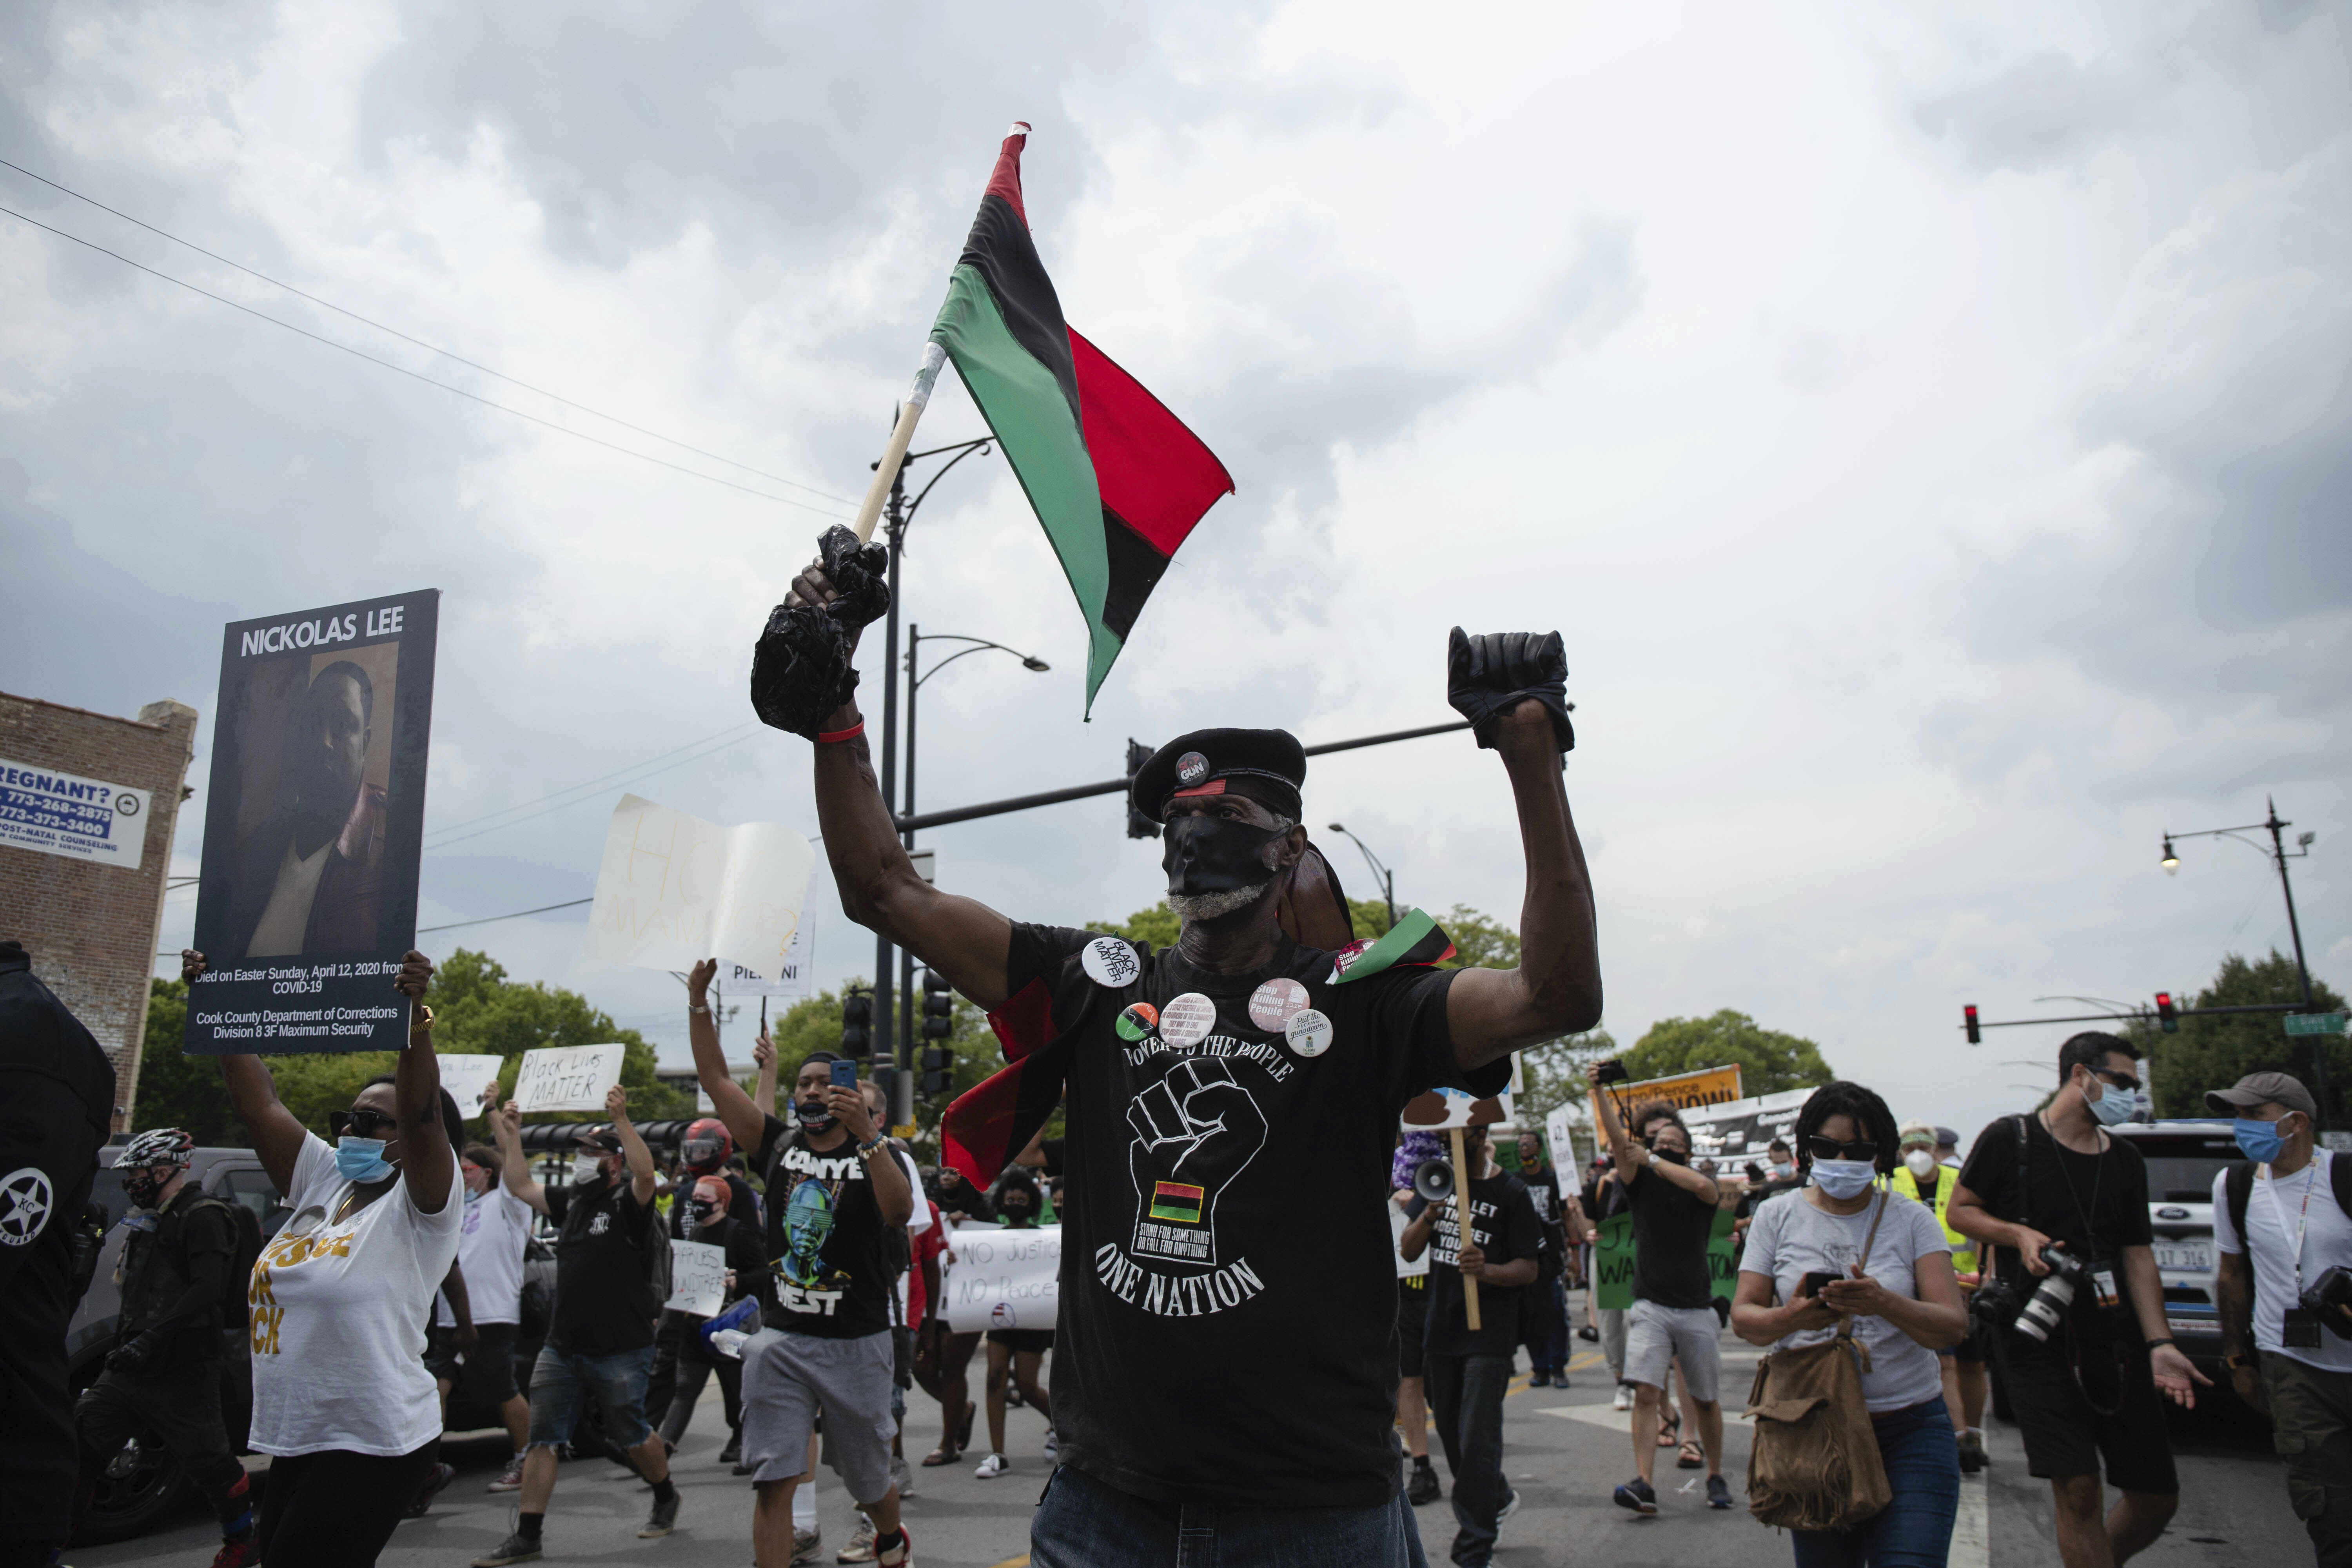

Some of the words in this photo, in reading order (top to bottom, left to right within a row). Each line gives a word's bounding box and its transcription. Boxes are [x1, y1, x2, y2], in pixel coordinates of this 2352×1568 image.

[241, 614, 357, 657] NICKOLAS
[366, 606, 404, 637] LEE
[1180, 762, 1204, 780] GUN
[1184, 771, 1206, 783] VIOLENCE
[7, 790, 111, 822] 773-268-2875
[9, 834, 56, 846] COMMUNITY
[60, 835, 117, 851] COUNSELING
[1094, 941, 1122, 982] MATTER
[1106, 946, 1128, 975] LIVES
[1113, 941, 1140, 976] BLACK
[1338, 951, 1355, 961] Stop
[195, 970, 218, 983] Died
[219, 972, 232, 982] on
[234, 969, 267, 981] Easter
[268, 965, 309, 980] Sunday,
[312, 964, 336, 980] April
[338, 964, 353, 978] 12,
[355, 962, 380, 976] 2020
[272, 981, 323, 994] COVID-19
[1256, 984, 1278, 995] Stop
[1250, 1003, 1283, 1016] People
[1252, 993, 1284, 1007] Killing
[196, 1011, 223, 1024] Cook
[225, 1011, 261, 1026] County
[263, 1009, 322, 1025] Department
[324, 1007, 336, 1020] of
[336, 1005, 398, 1020] Corrections
[1296, 1013, 1310, 1025] Put
[1310, 1011, 1320, 1020] the
[214, 1025, 254, 1038] Division
[256, 1025, 263, 1037] 8
[264, 1024, 278, 1037] 3F
[279, 1023, 329, 1037] Maximum
[331, 1022, 374, 1038] Security
[1289, 1029, 1306, 1042] guns
[1307, 1023, 1327, 1032] down
[1201, 1035, 1236, 1057] THE
[522, 1052, 561, 1083] Black
[571, 1053, 604, 1070] Lives
[527, 1073, 598, 1108] MATTER
[780, 1145, 864, 1180] KANYE
[18, 1198, 35, 1214] KC
[1471, 1200, 1498, 1218] LET
[1139, 1222, 1159, 1238] STAND
[1158, 1225, 1172, 1240] FOR
[1171, 1227, 1210, 1245] SOMETHING
[1439, 1234, 1462, 1251] YOU
[963, 1242, 995, 1265] NO
[1006, 1238, 1061, 1262] Justic
[1137, 1236, 1147, 1250] OR
[1146, 1237, 1159, 1252] FALL
[1159, 1240, 1174, 1254] FOR
[1173, 1241, 1208, 1258] ANYTHING
[960, 1278, 988, 1305] NO
[999, 1275, 1054, 1299] Peace
[1096, 1243, 1143, 1304] ONE
[1142, 1256, 1265, 1316] NATION
[774, 1274, 843, 1315] WEST
